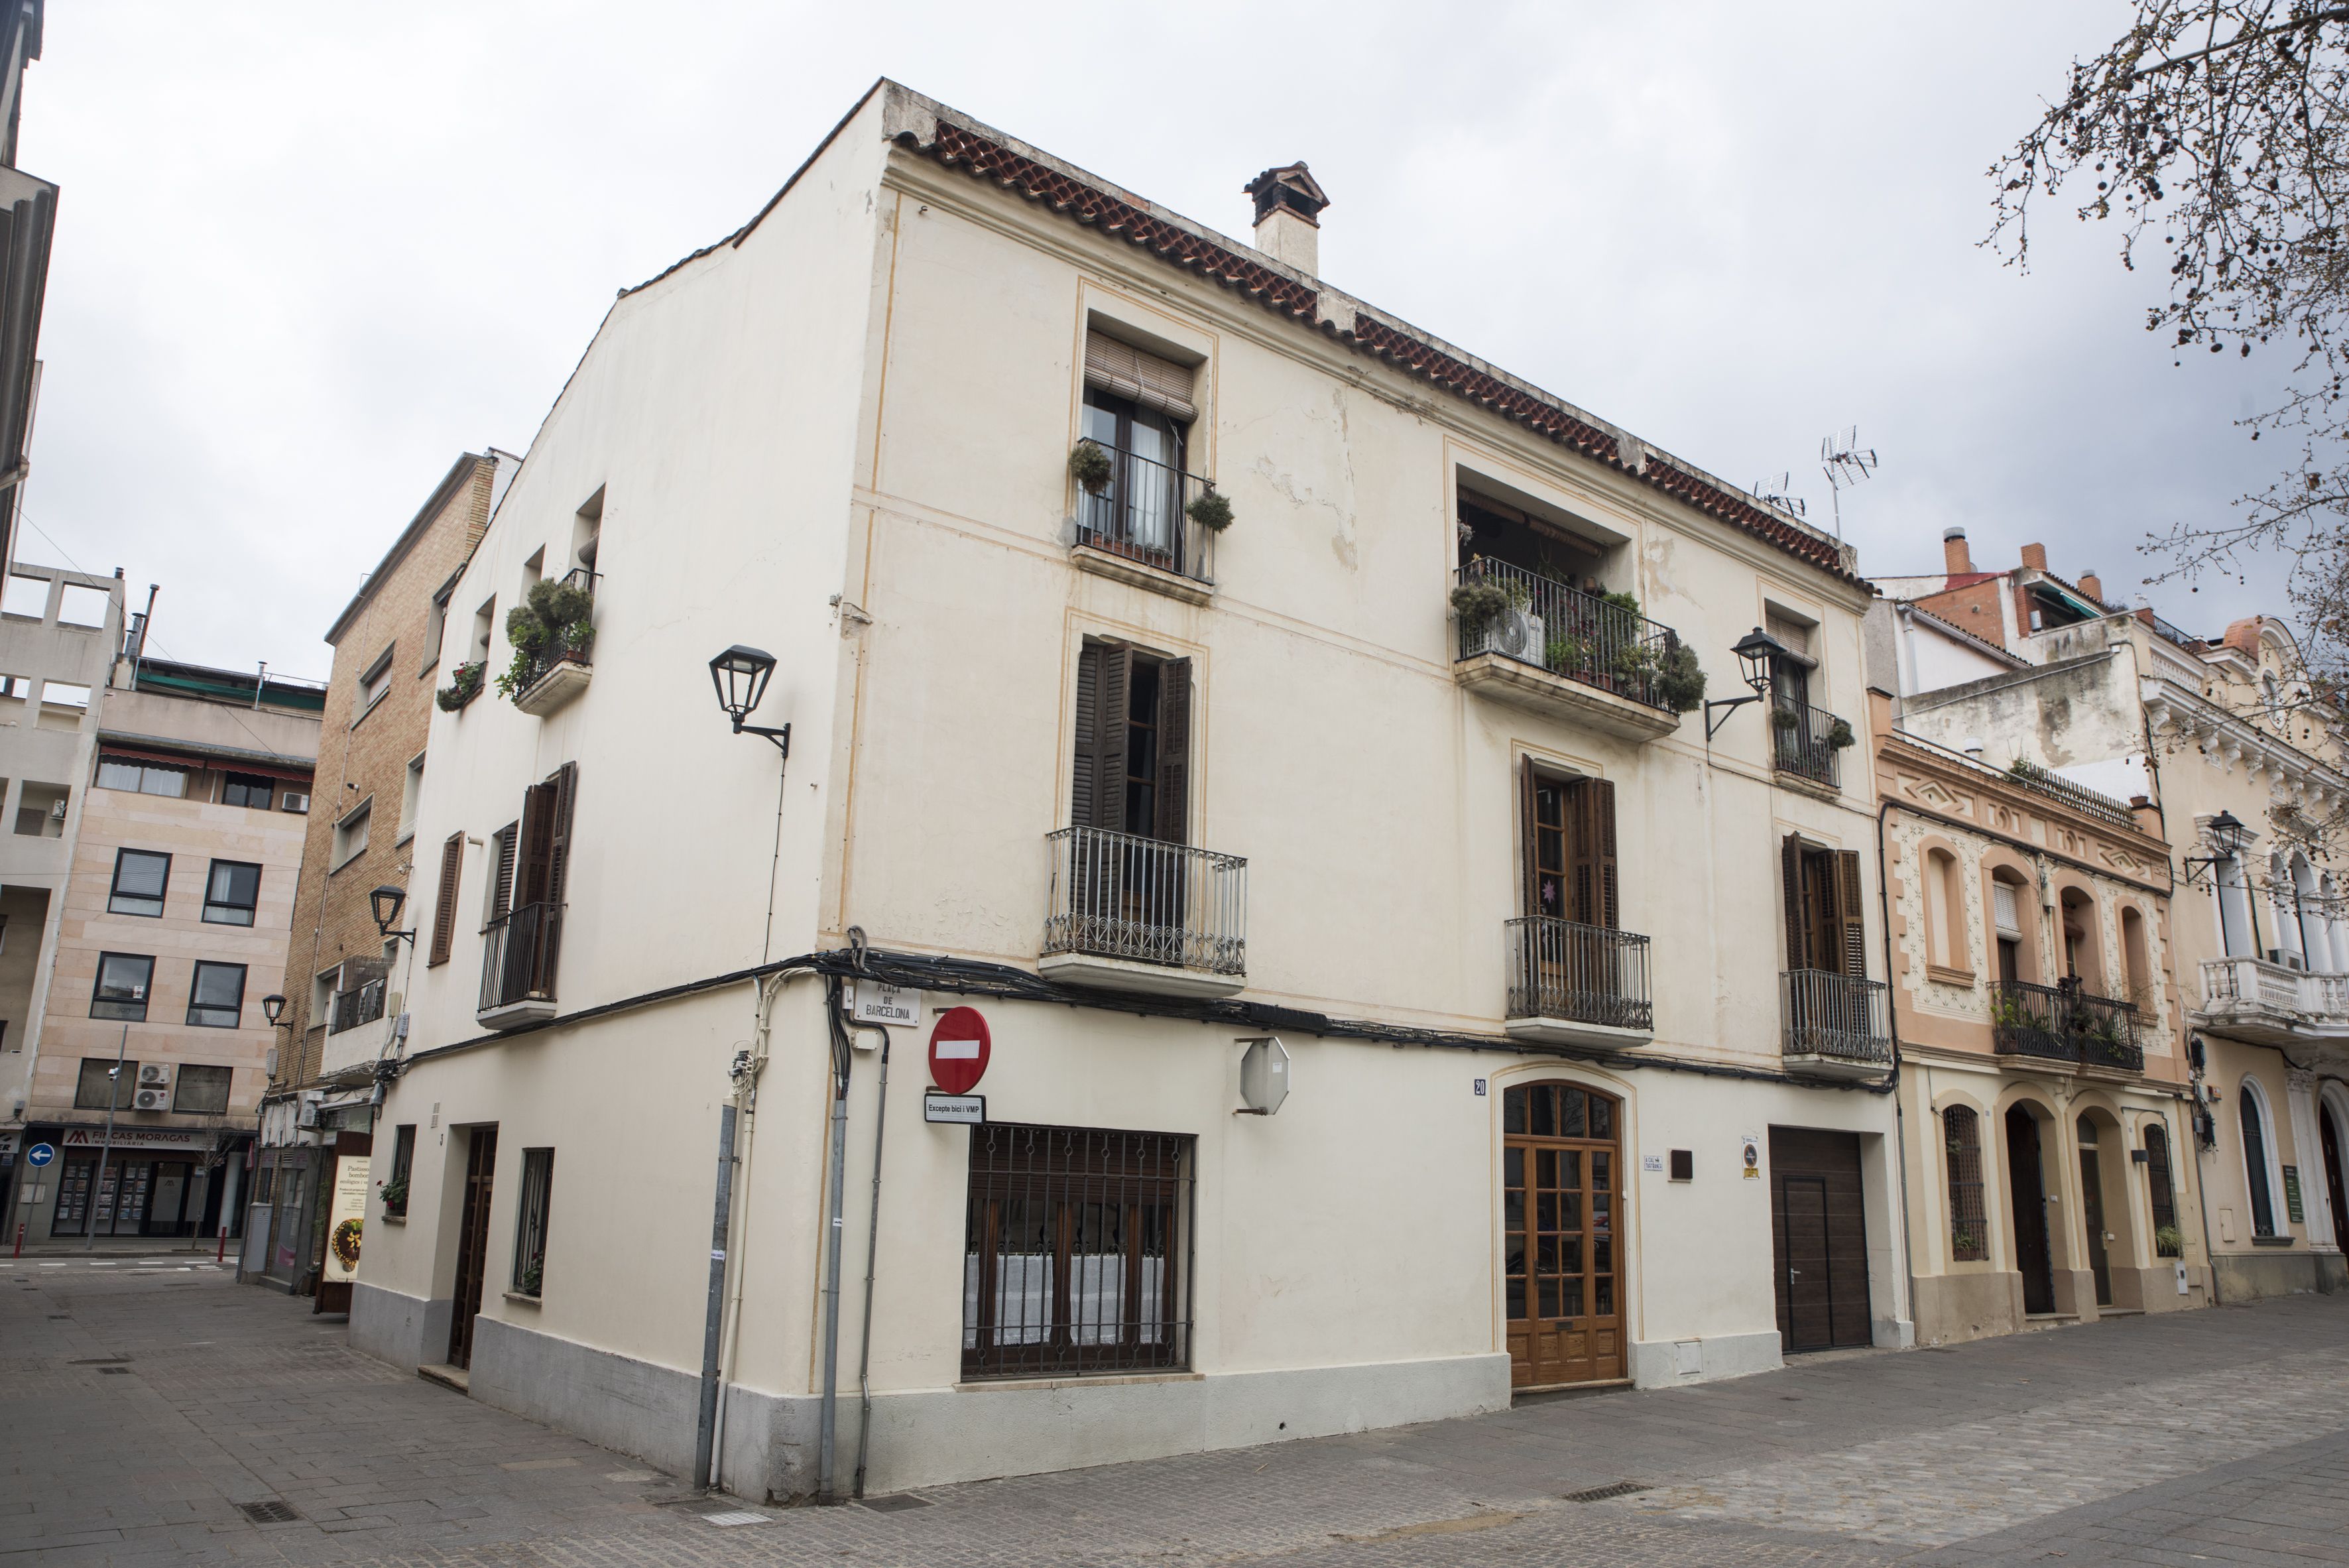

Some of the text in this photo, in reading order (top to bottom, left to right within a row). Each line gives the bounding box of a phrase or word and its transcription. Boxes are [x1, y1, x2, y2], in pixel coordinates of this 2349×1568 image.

[877, 983, 901, 995] PLAÇA
[883, 996, 893, 1005] DE
[866, 1004, 910, 1020] BARCELONA
[1476, 1080, 1485, 1095] 20
[928, 1104, 950, 1114] Excepte
[135, 1132, 190, 1142] MORAGAS
